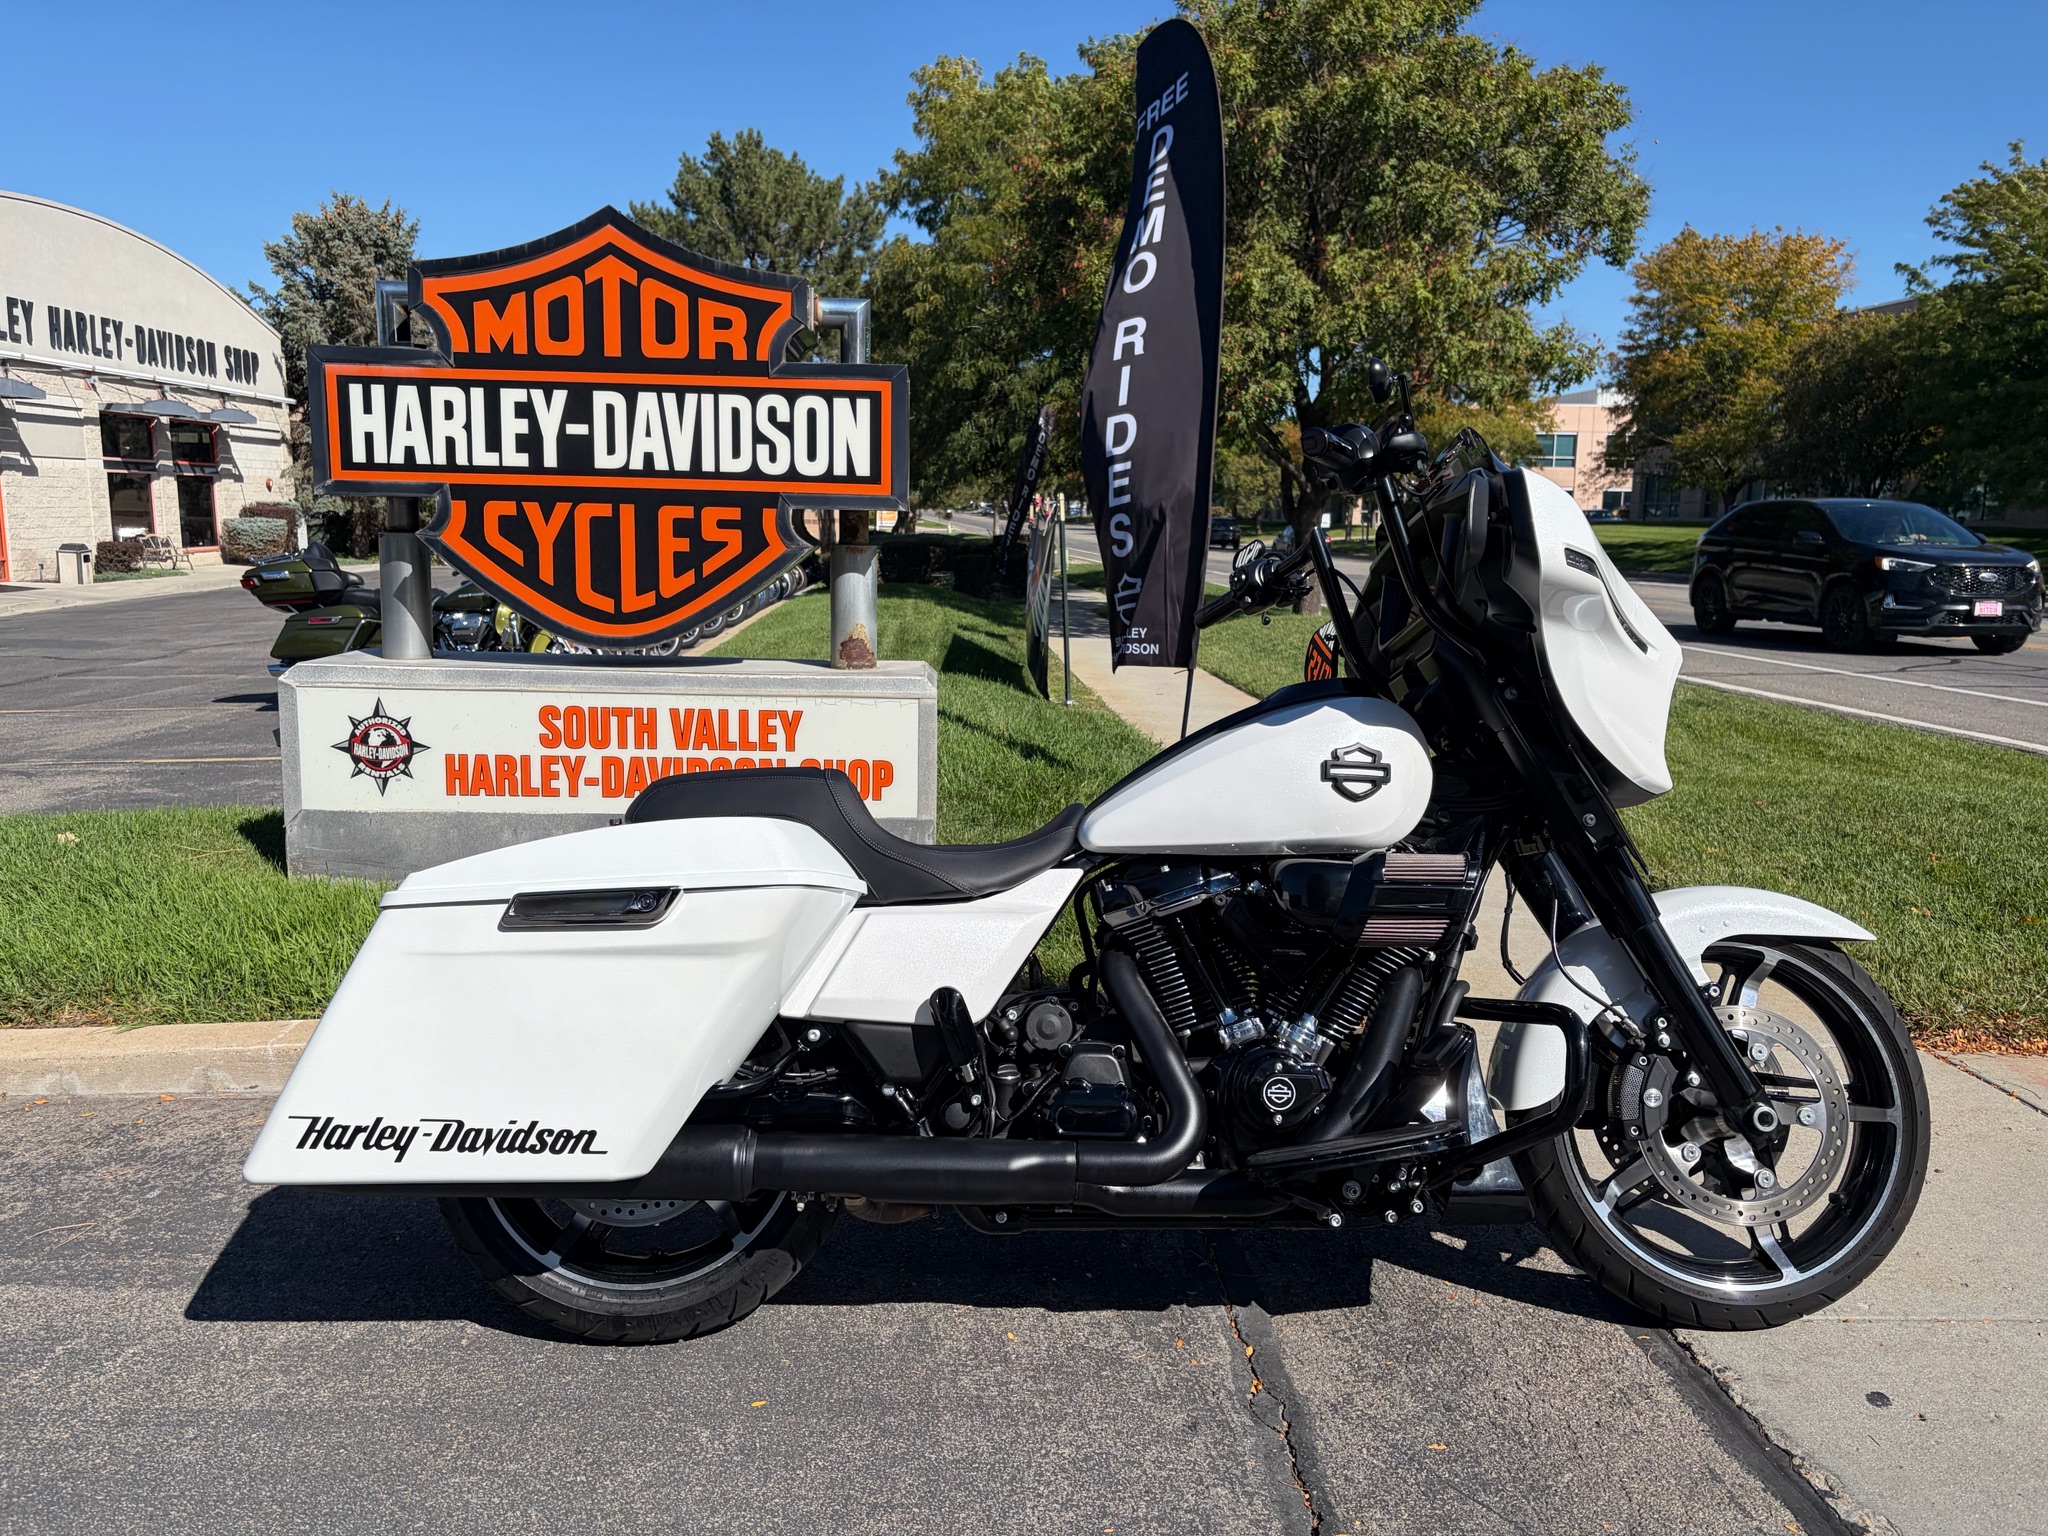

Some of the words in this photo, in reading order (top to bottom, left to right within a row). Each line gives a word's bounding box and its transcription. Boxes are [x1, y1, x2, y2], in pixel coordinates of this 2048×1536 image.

[1136, 71, 1189, 142] FREE
[1123, 124, 1174, 294] DEMO
[47, 305, 218, 379] HARLEY-DAVIDSON
[224, 344, 260, 386] SHOP
[472, 254, 748, 361] MOTOR
[348, 382, 871, 477] HARLEY-DAVIDSON
[1105, 316, 1147, 558] RIDES
[483, 500, 743, 614] CYCLES
[353, 742, 409, 760] HARLEY-DAVIDSON
[354, 716, 407, 737] AUTHORIZED
[538, 704, 658, 749] SOUTH
[669, 708, 803, 752] VALLEY
[445, 754, 787, 798] HARLEY-DAV
[288, 1116, 608, 1163] Harley-Davidson
